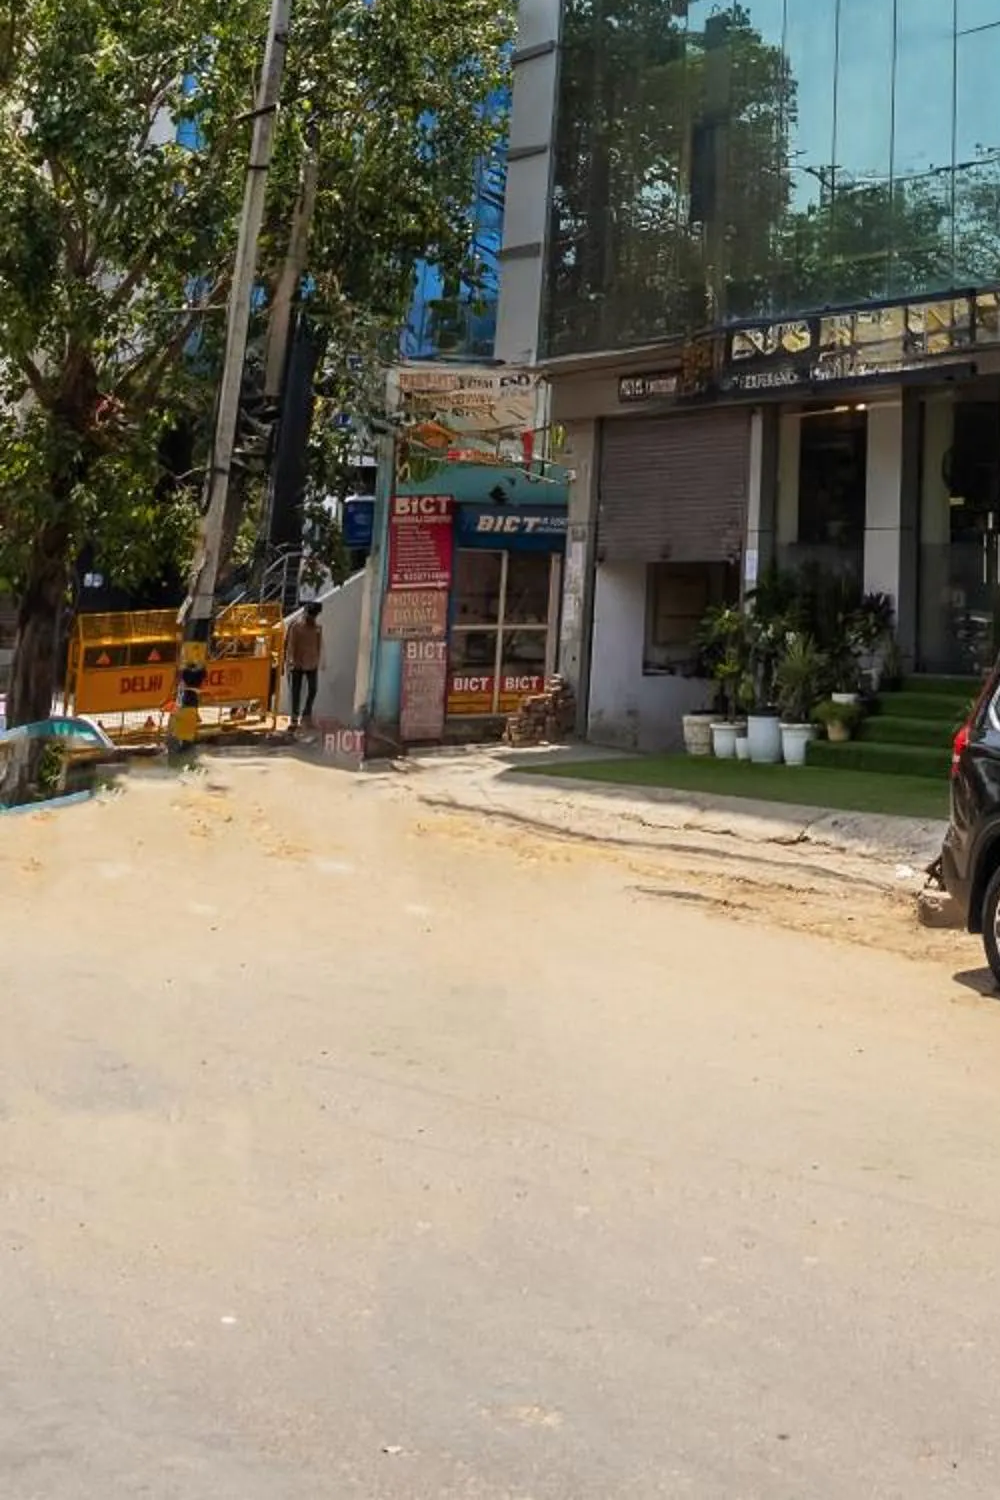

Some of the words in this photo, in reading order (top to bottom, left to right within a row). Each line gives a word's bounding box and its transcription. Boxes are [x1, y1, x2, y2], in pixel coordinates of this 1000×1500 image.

[394, 496, 451, 515] BICT
[476, 515, 540, 533] BICT
[406, 642, 447, 660] BICT
[453, 677, 490, 691] BICT
[504, 676, 539, 690] BICT
